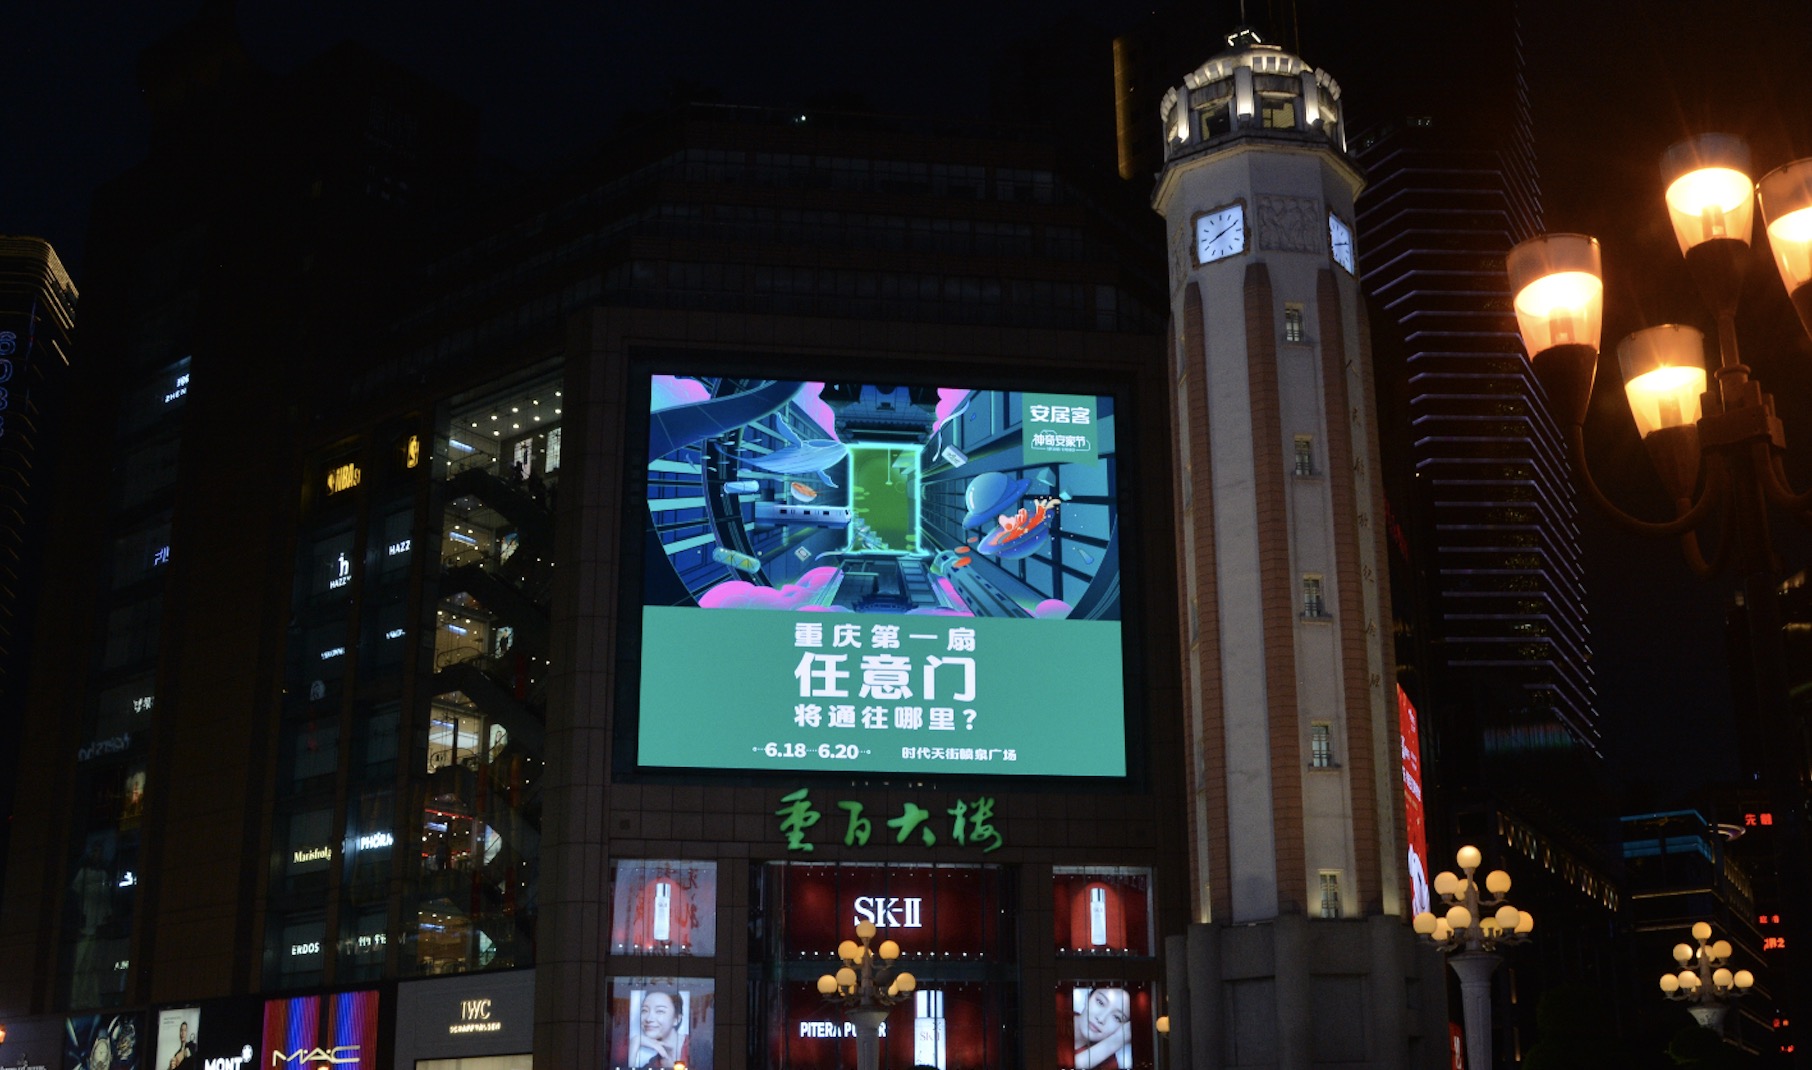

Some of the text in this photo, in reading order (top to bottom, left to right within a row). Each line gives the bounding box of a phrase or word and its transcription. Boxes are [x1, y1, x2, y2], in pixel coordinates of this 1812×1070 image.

[1030, 405, 1090, 424] 安居客
[1033, 433, 1086, 447] 神奇安家节
[794, 622, 976, 651] 重庆第一扇
[794, 652, 976, 701] 任意门
[775, 788, 1003, 852] 重百大楼
[854, 896, 922, 928] SK-II
[291, 941, 320, 956] ERDOS
[461, 999, 491, 1020] IWC
[204, 1056, 243, 1070] MONT
